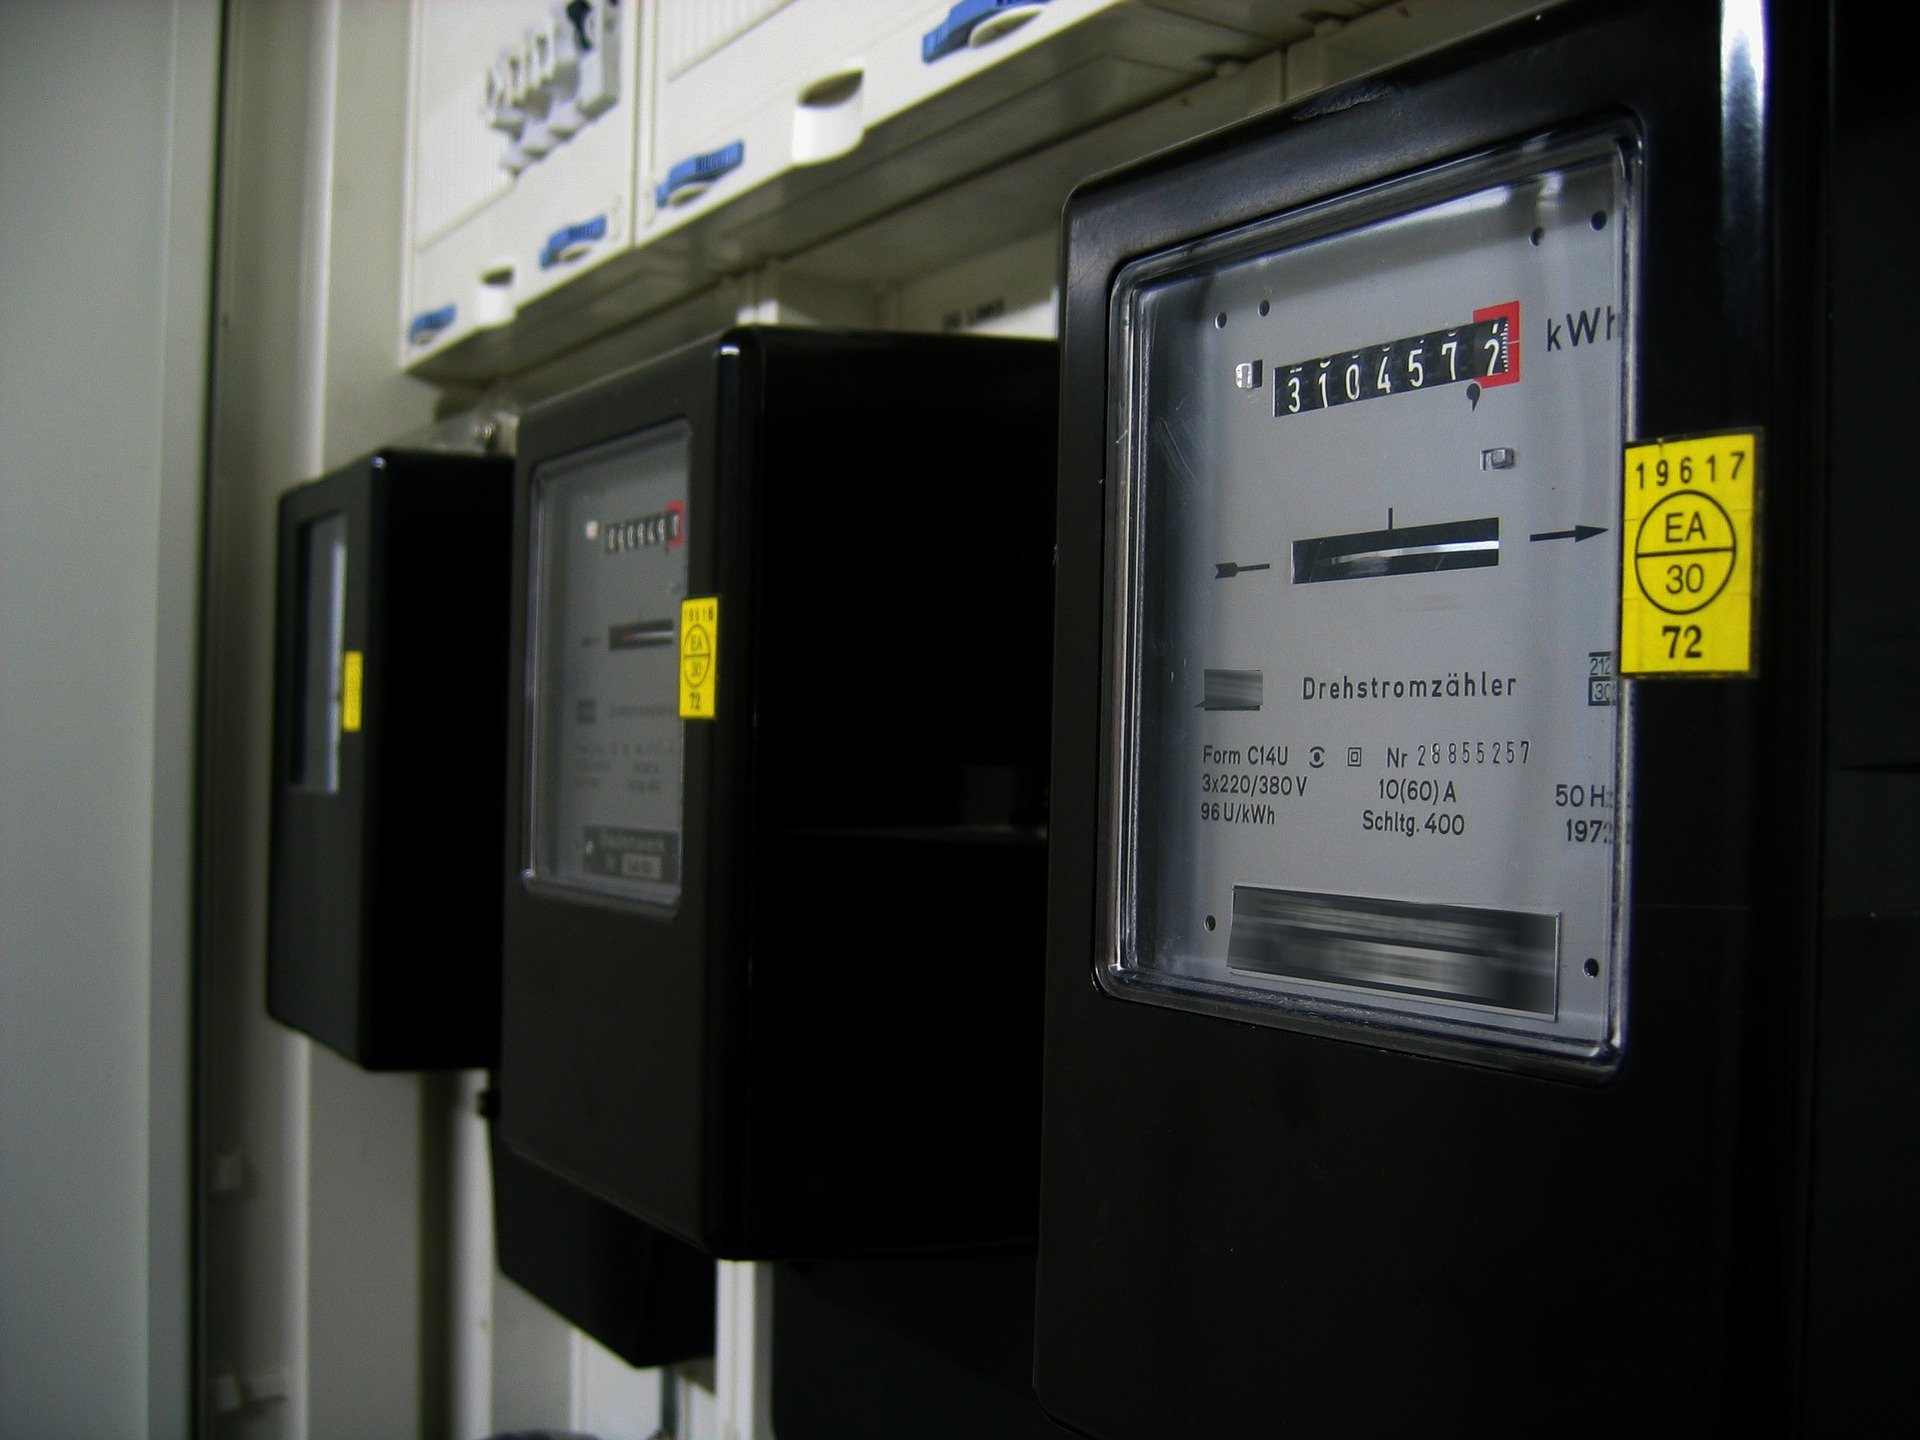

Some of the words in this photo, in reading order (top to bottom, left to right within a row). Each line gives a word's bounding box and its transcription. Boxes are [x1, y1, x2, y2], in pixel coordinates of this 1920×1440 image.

[1636, 451, 1746, 490] 19617
[1665, 511, 1707, 543] EA
[1666, 563, 1704, 594] 30
[1661, 624, 1703, 659] 72
[1303, 671, 1517, 700] Drehstromzähler
[1202, 745, 1241, 765] Form
[1248, 745, 1289, 766] C14U
[1387, 747, 1408, 768] Nr
[1417, 741, 1530, 767] 28855257
[1202, 773, 1293, 797] 3x220/380
[1296, 776, 1308, 796] V
[1379, 778, 1439, 806] 10(60)
[1443, 780, 1457, 803] A
[1555, 784, 1585, 808] 50
[1362, 809, 1420, 838] Schltg.
[1424, 812, 1465, 836] 400
